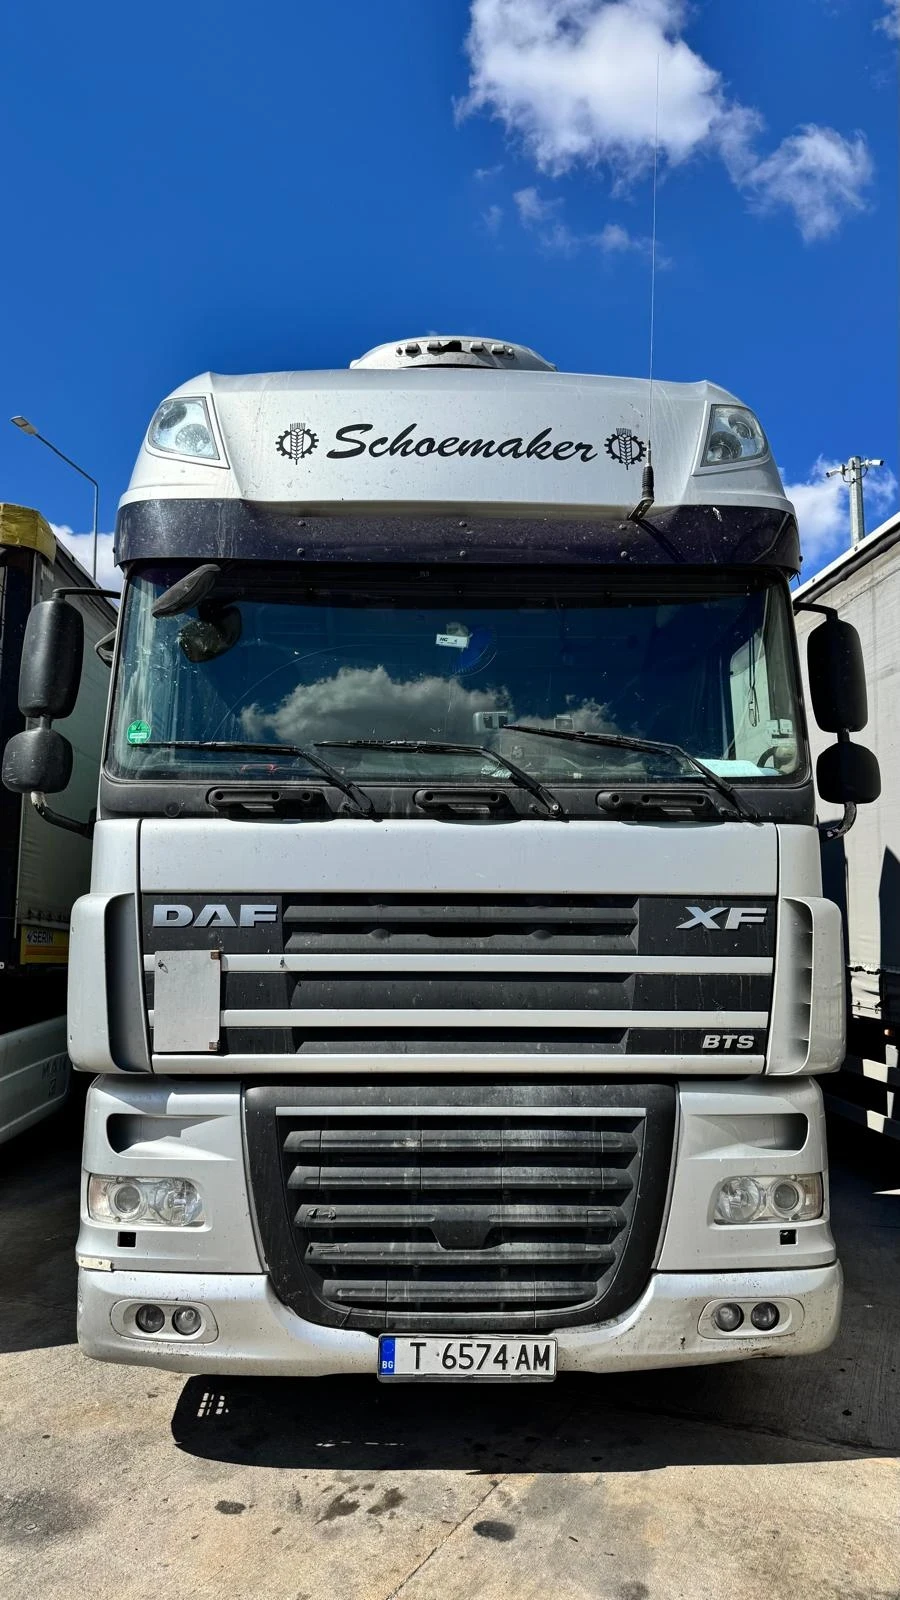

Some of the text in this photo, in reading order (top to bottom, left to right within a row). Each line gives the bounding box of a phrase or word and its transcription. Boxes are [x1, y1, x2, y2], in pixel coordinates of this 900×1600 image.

[326, 423, 598, 463] Schoemaker
[152, 904, 278, 927] DAF
[675, 906, 768, 930] XF
[702, 1034, 755, 1049] BTS
[381, 1360, 394, 1369] BG
[409, 1342, 551, 1371] T 6574 AM
